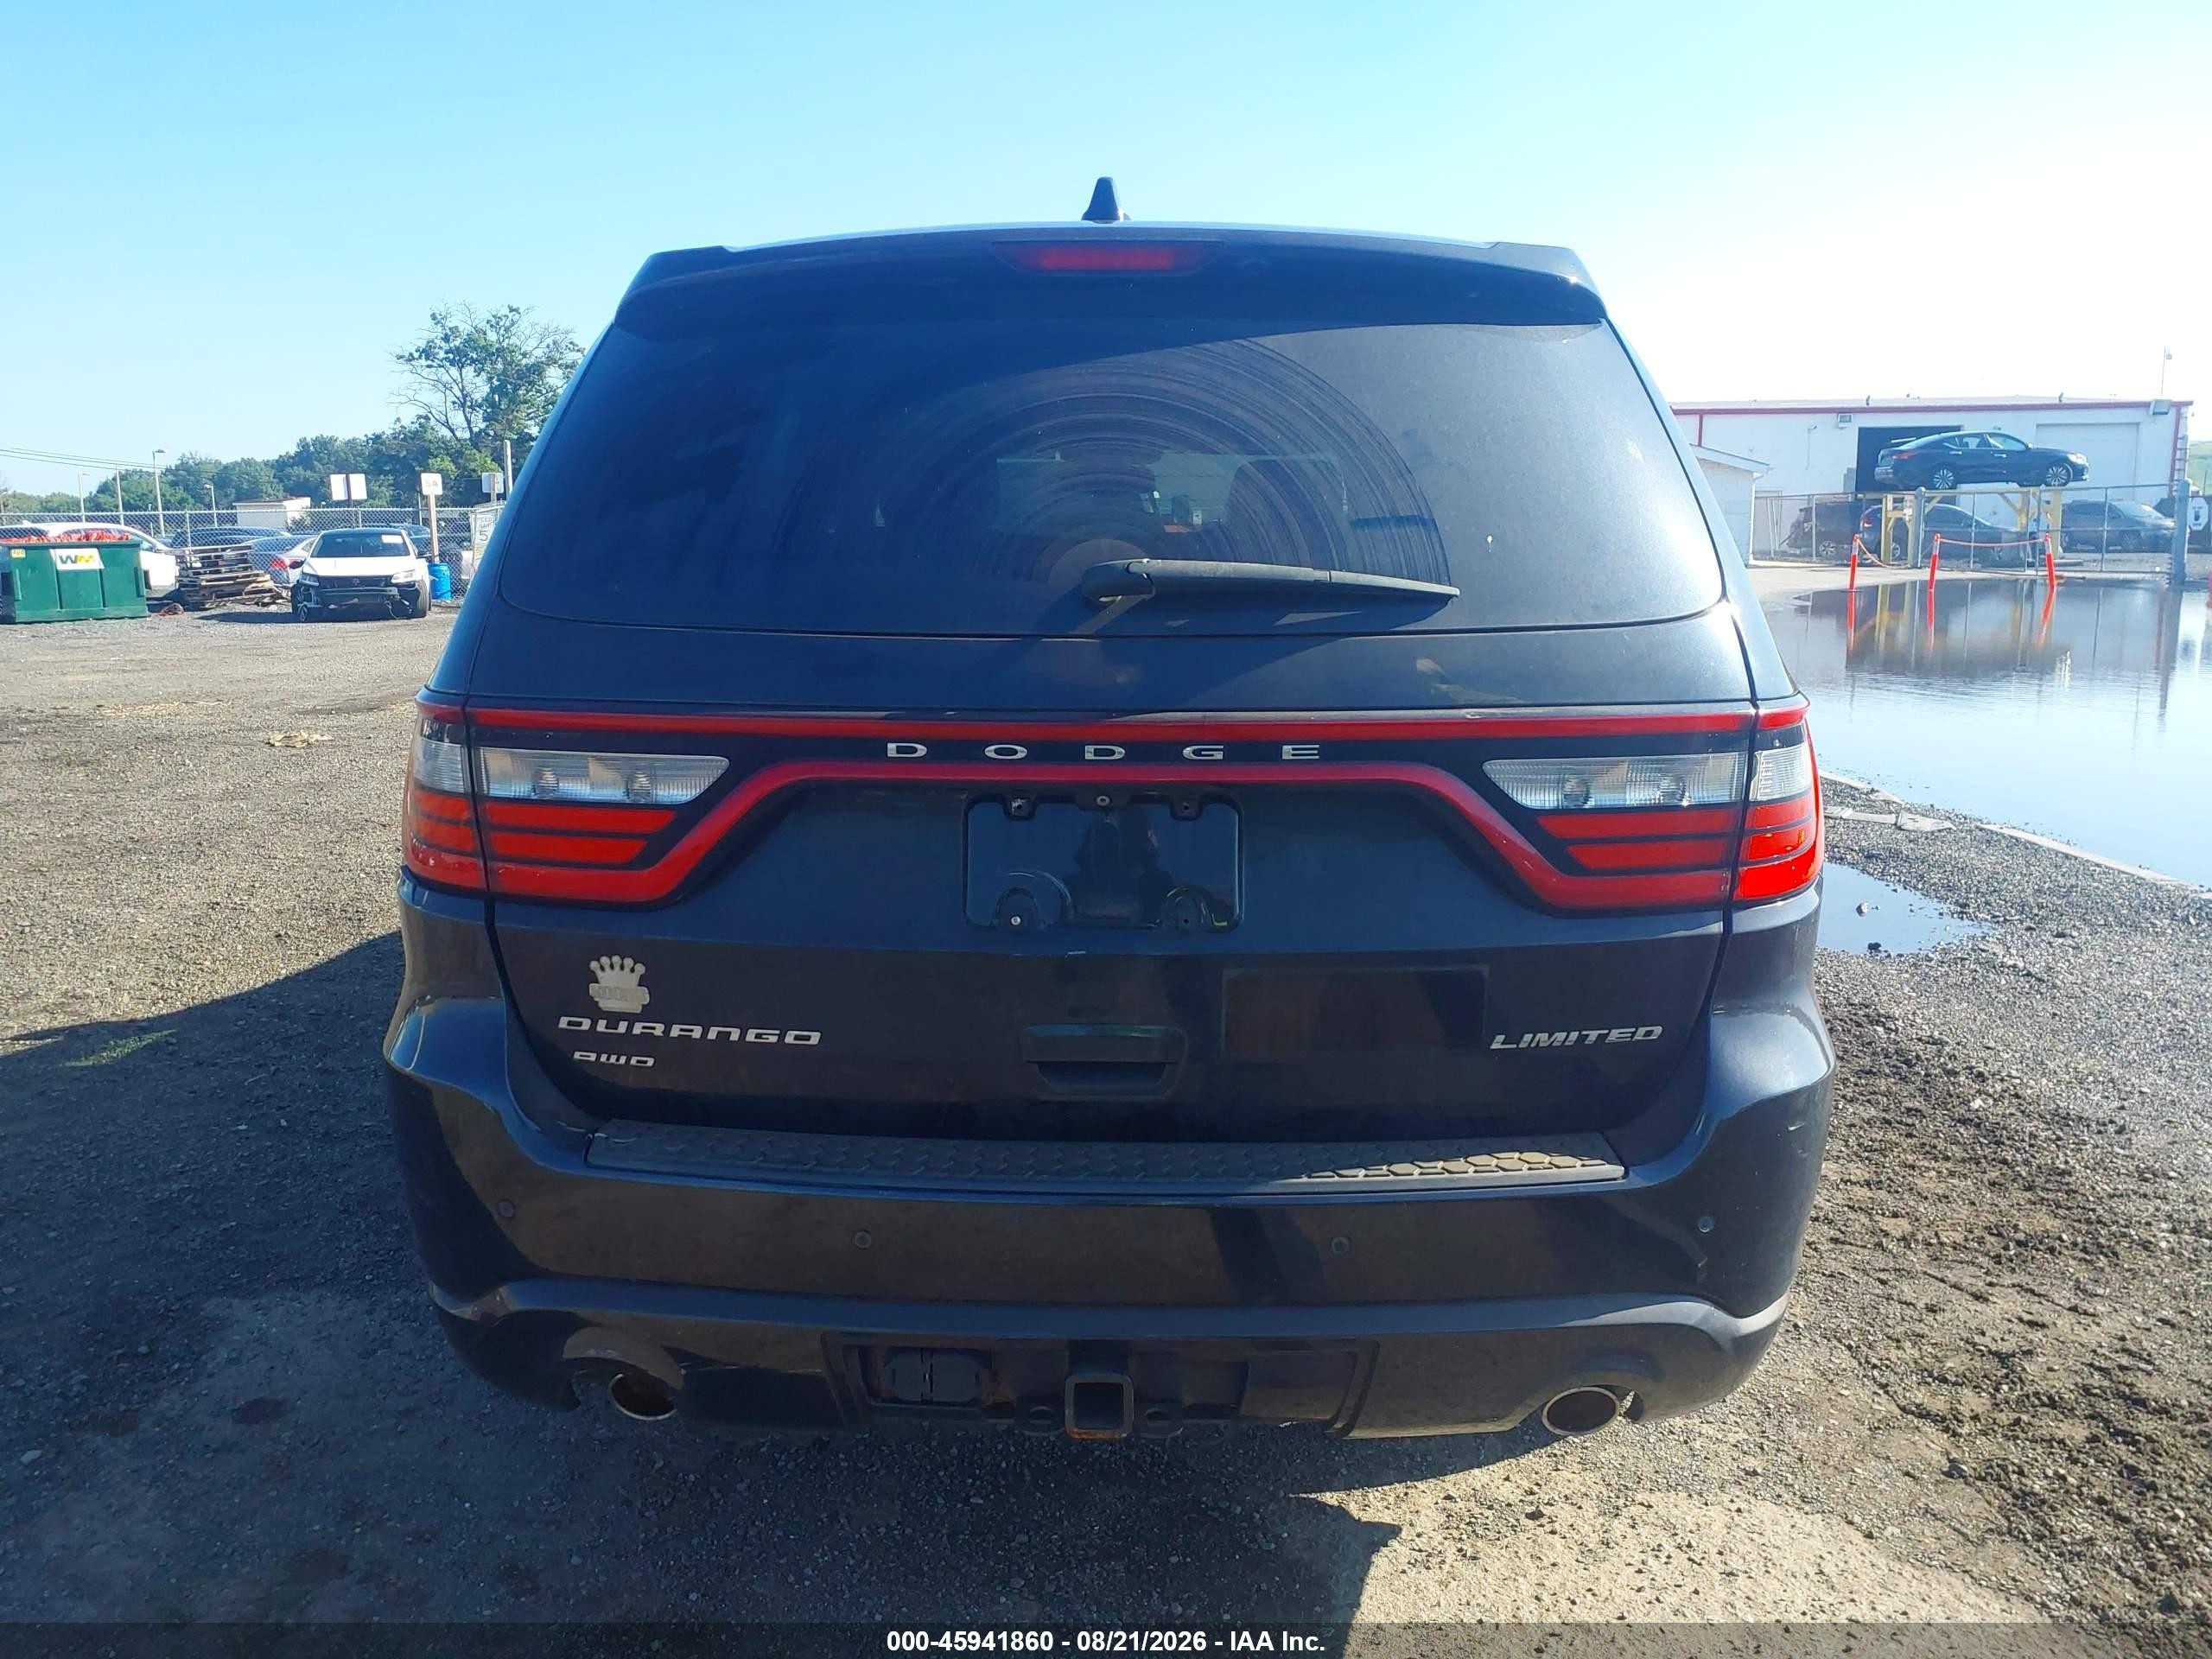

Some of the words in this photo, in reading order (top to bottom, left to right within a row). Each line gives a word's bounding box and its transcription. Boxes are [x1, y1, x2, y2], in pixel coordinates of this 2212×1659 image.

[58, 554, 95, 564] WM
[887, 742, 1320, 760] DODGE
[558, 1016, 822, 1045] DURANGO
[1490, 1026, 1663, 1049] LIMITED
[573, 1051, 655, 1067] AWD
